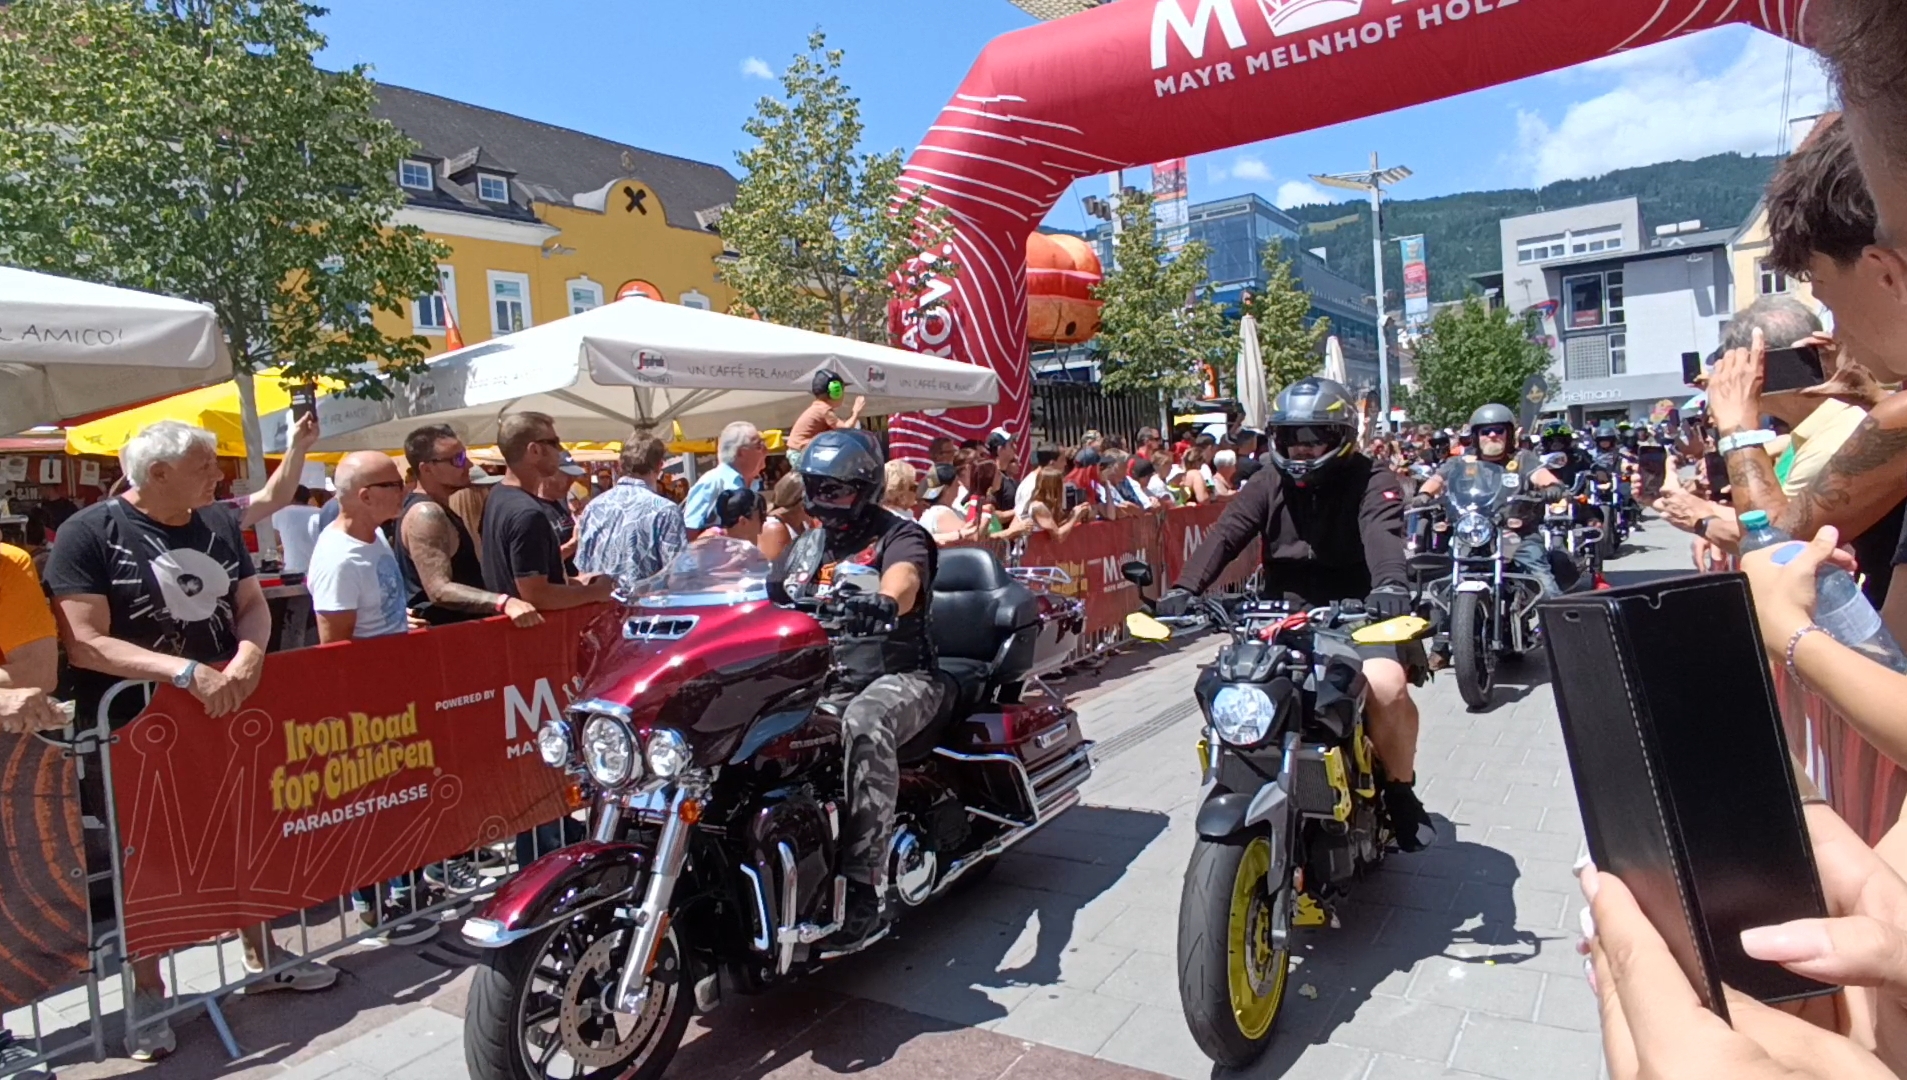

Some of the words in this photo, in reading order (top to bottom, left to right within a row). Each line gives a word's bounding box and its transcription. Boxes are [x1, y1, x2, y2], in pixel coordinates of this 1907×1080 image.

[1154, 61, 1235, 98] MAYR
[1245, 15, 1403, 75] MELNHOF
[1417, 0, 1519, 30] HOL
[21, 324, 123, 346] AMICO!
[687, 365, 706, 376] UN
[749, 367, 769, 380] PER
[435, 691, 482, 711] POWERED
[483, 689, 496, 700] BY
[283, 718, 349, 765] Iron
[348, 701, 418, 748] Road
[269, 765, 320, 812] for
[324, 738, 436, 800] Children
[283, 783, 429, 838] PARADESTRASSE
